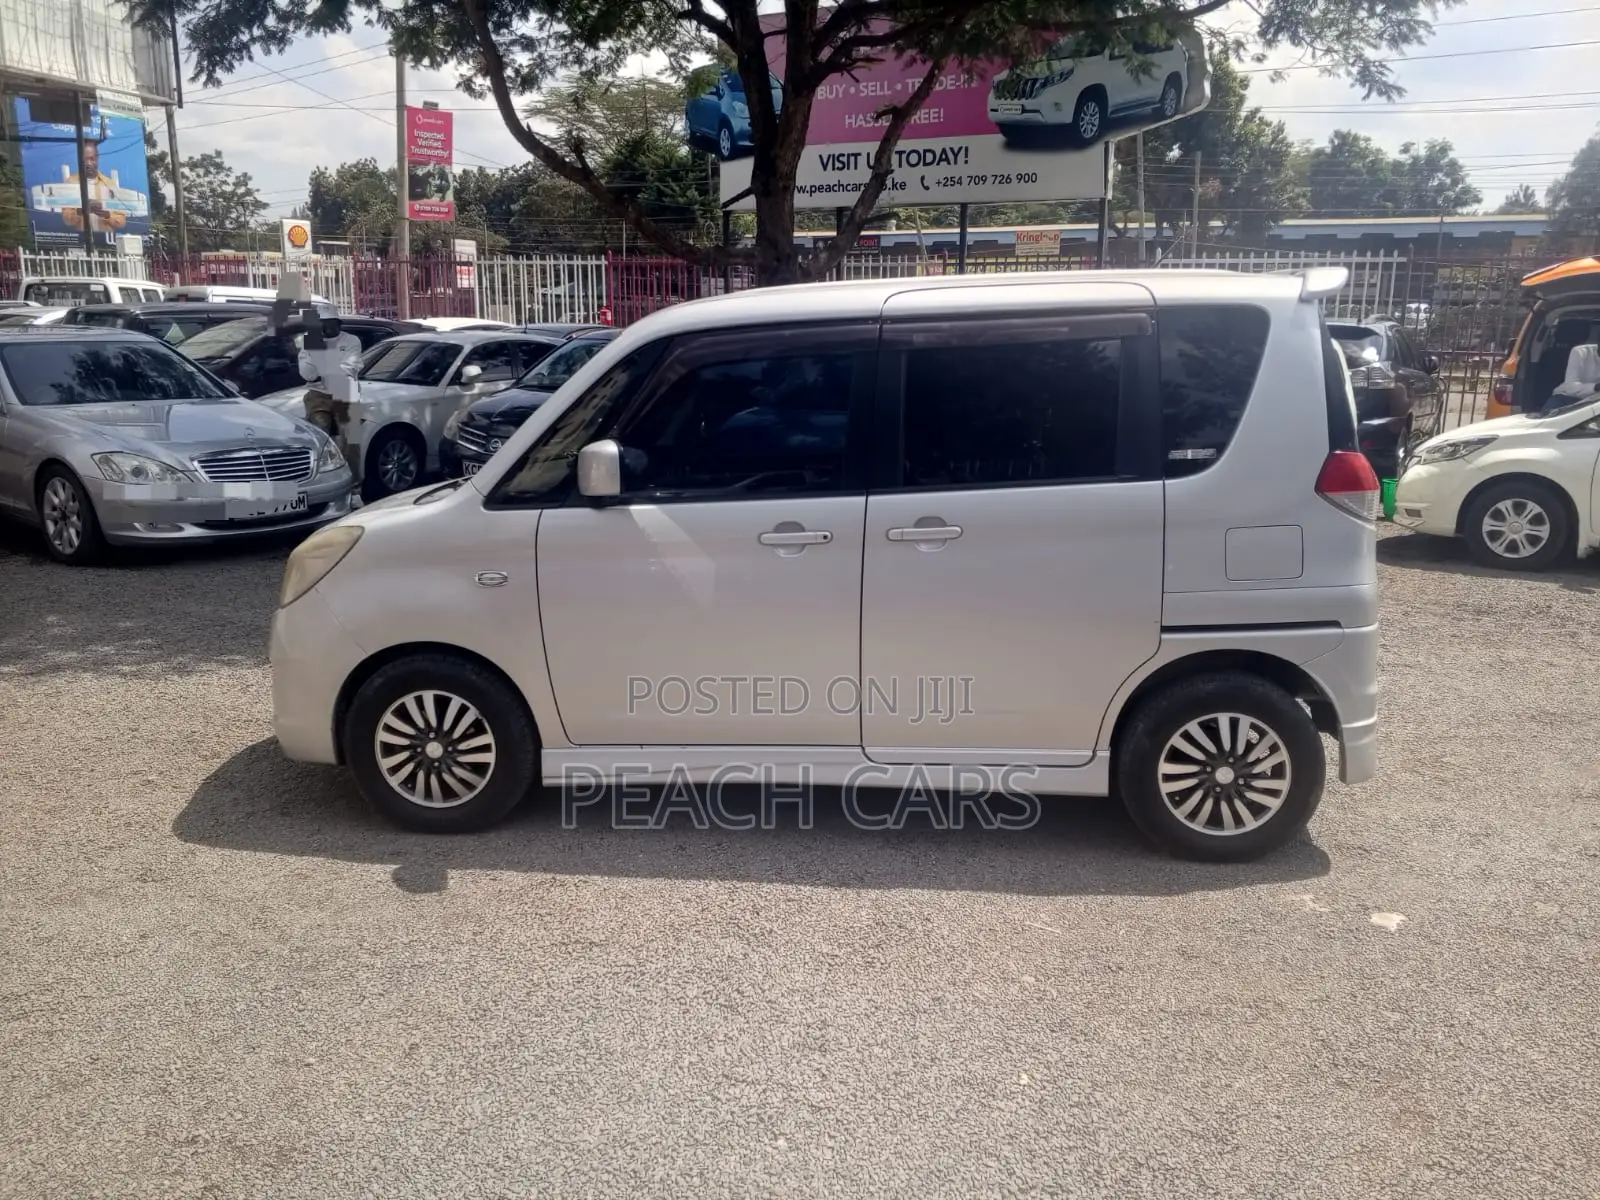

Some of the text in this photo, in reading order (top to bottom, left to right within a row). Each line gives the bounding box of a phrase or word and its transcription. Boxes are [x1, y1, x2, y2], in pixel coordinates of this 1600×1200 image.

[817, 84, 846, 100] BUY
[860, 81, 891, 97] SELL
[818, 152, 862, 172] VISIT
[894, 146, 969, 169] TODAY!
[935, 176, 963, 190] +254
[967, 174, 986, 189] 709
[991, 172, 1013, 188] 726
[1016, 171, 1038, 187] 900
